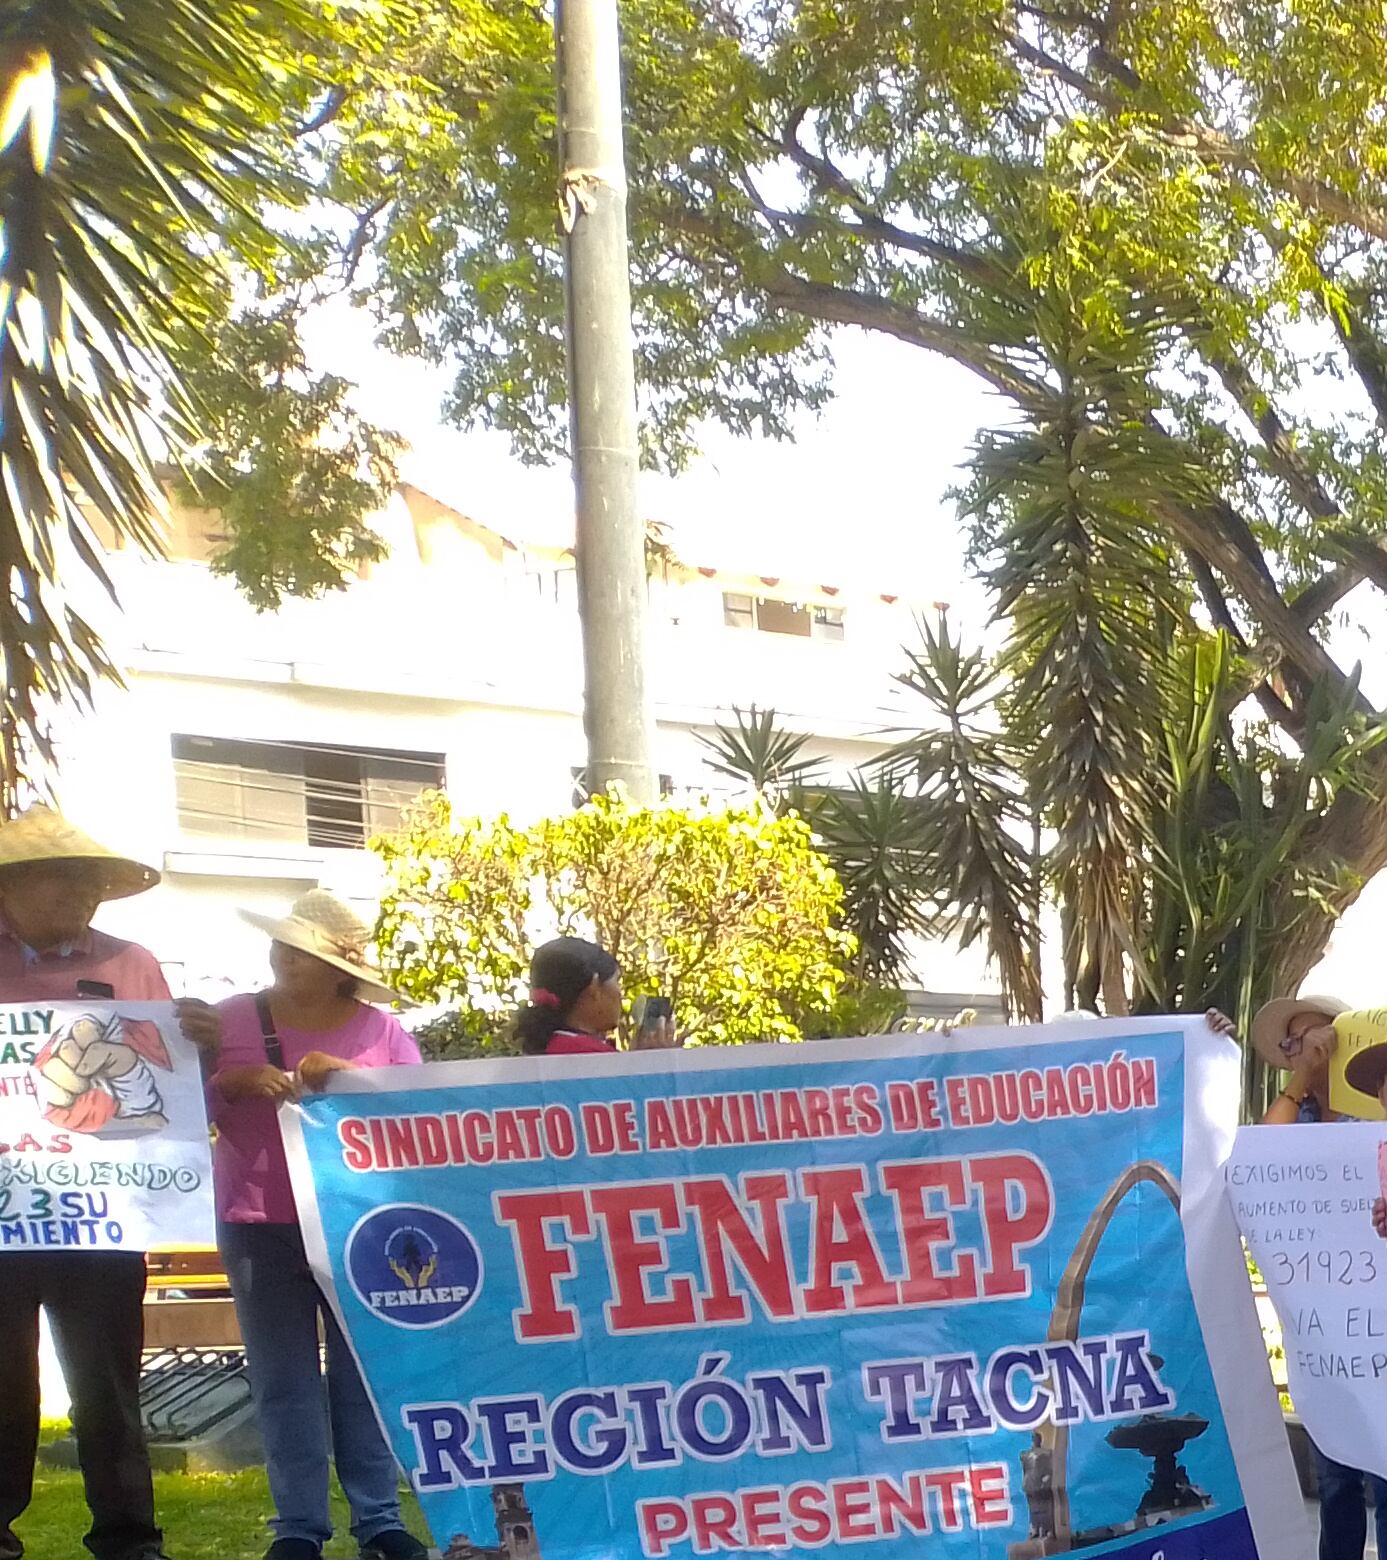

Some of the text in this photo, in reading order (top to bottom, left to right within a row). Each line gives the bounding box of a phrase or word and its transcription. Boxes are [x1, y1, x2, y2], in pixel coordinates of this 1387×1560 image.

[341, 1053, 1157, 1171] SINDICATO DE AUXILIARES DE EDUCACIÓN
[1342, 1165, 1364, 1181] EL
[60, 1191, 108, 1219] SU
[1239, 1200, 1306, 1217] AUMENTO
[1315, 1200, 1332, 1214] DE
[499, 1154, 1051, 1339] FENAEP
[1265, 1230, 1283, 1243] LA
[1288, 1227, 1317, 1242] LEY
[1272, 1249, 1378, 1286] 31923
[370, 1286, 470, 1307] FENAEP
[1346, 1307, 1385, 1338] EL
[405, 1333, 1171, 1488] REGIÓN TACNA
[642, 1466, 1010, 1554] PRESENTE
